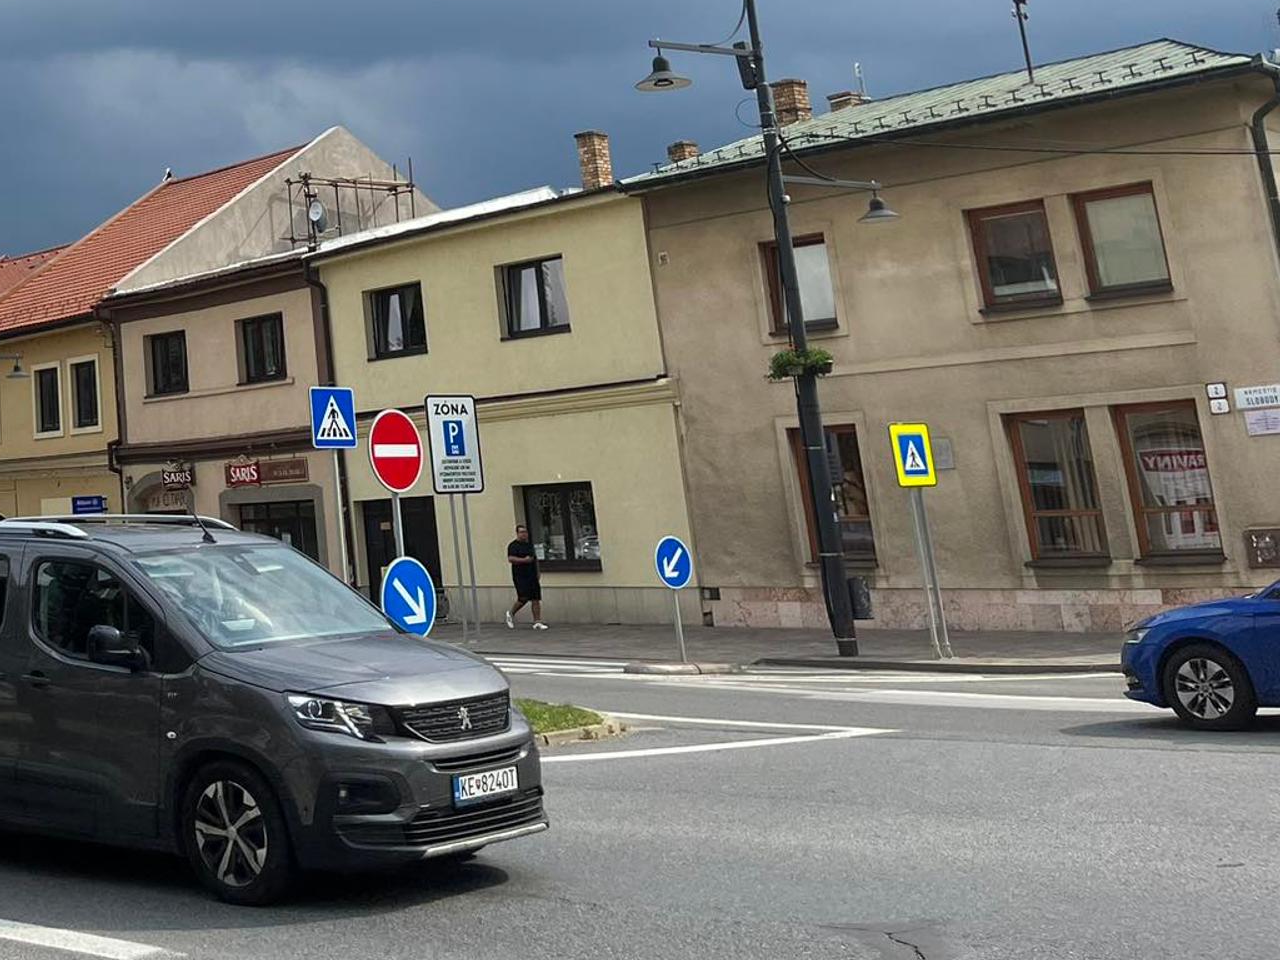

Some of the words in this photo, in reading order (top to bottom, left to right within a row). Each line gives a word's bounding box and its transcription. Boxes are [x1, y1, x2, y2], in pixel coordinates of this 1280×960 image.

[433, 401, 468, 415] ZÓNA
[449, 423, 458, 443] P
[460, 777, 475, 797] KE
